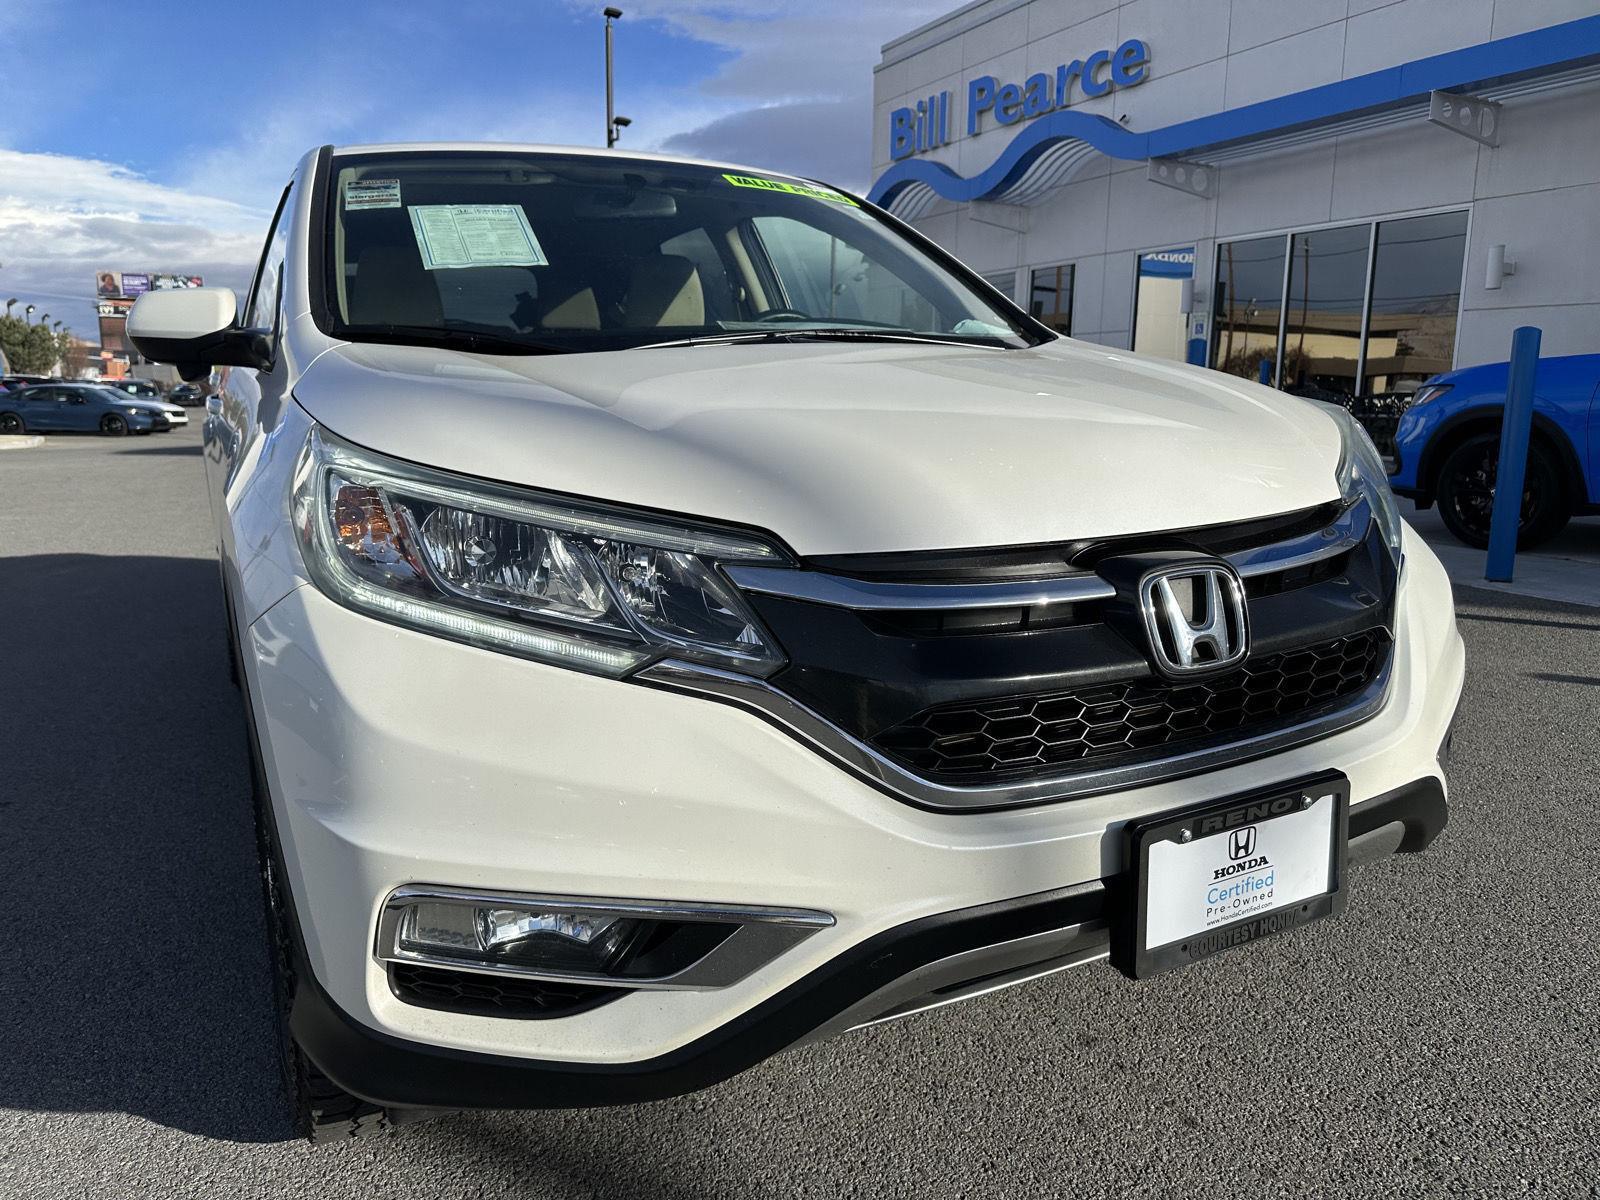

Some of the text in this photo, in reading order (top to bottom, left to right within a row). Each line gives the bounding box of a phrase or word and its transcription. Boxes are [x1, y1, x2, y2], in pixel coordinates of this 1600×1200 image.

[890, 39, 1151, 161] Bill Pearce
[732, 176, 786, 191] VALUE
[1201, 798, 1293, 833] RENO
[1213, 856, 1269, 880] HONDA
[1207, 869, 1274, 904] Certified
[1206, 888, 1273, 918] Pre-Owned
[1206, 901, 1273, 927] www.HondaCertified.com
[1189, 908, 1300, 958] COURTESY HONDA
